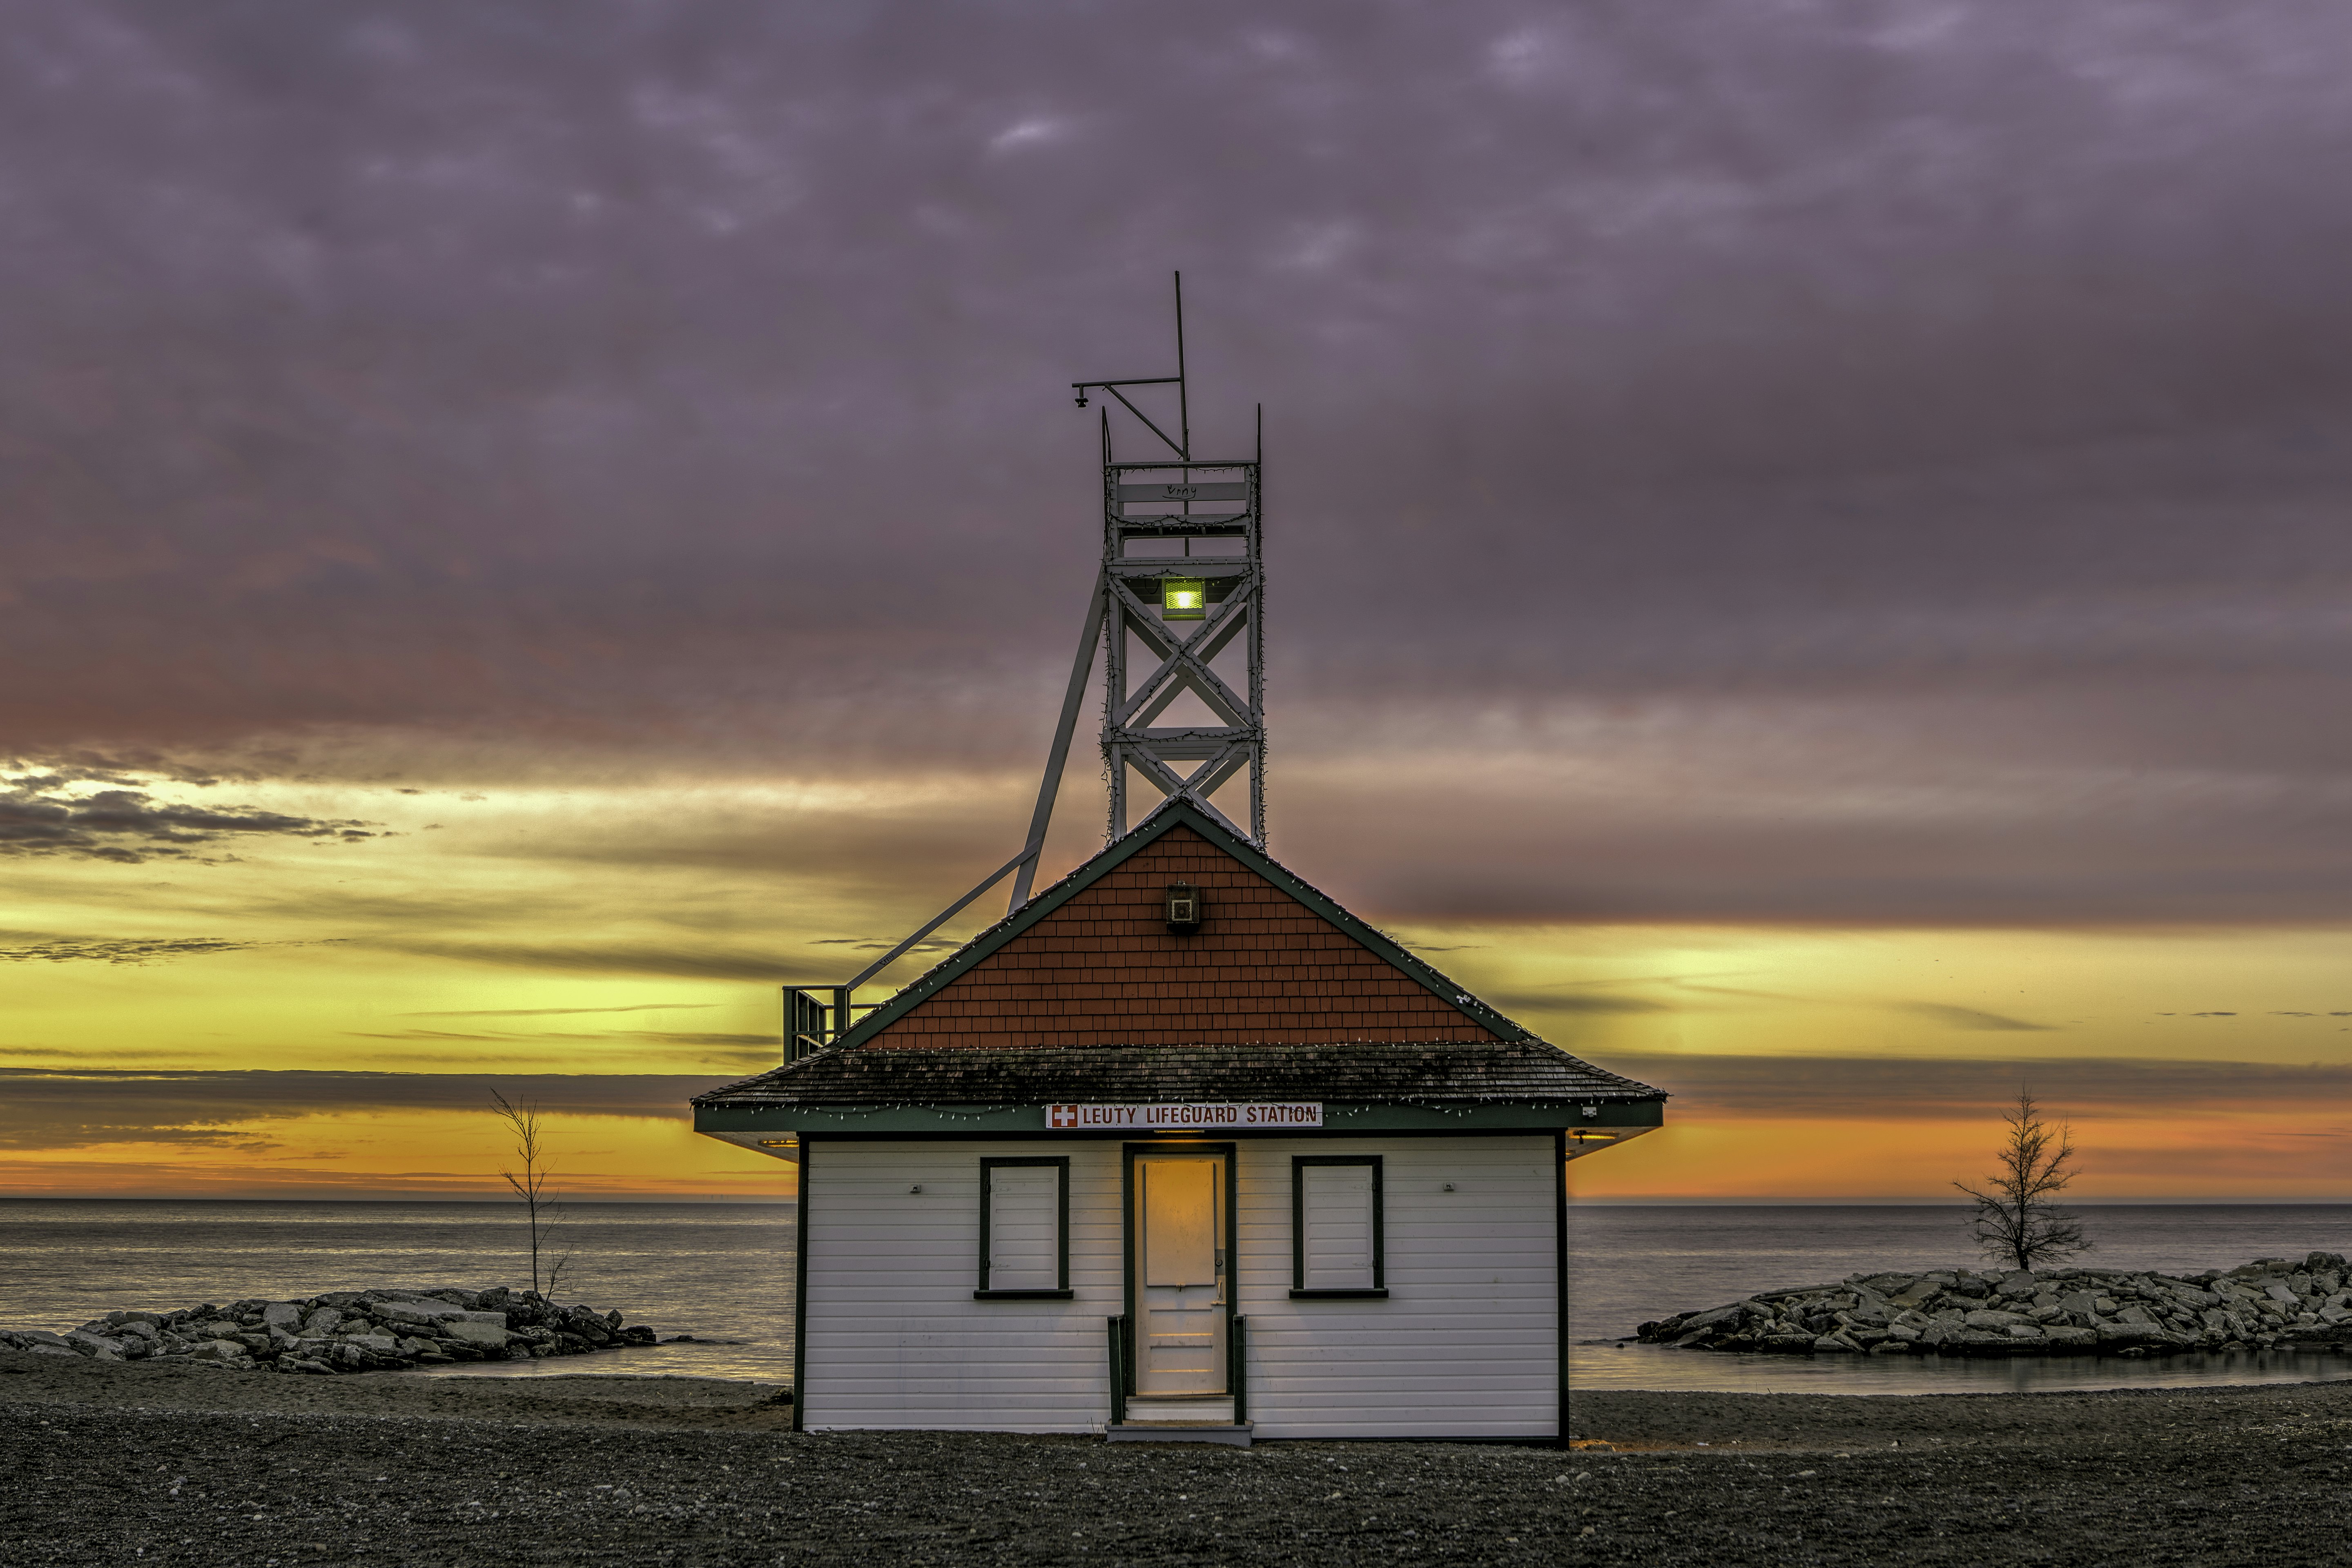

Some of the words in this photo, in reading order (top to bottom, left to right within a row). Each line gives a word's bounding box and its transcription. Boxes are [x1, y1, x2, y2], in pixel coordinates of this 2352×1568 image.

[1083, 1107, 1136, 1123] LEUTY
[1147, 1107, 1237, 1123] LIFEGUARD
[1247, 1106, 1316, 1123] STATION
